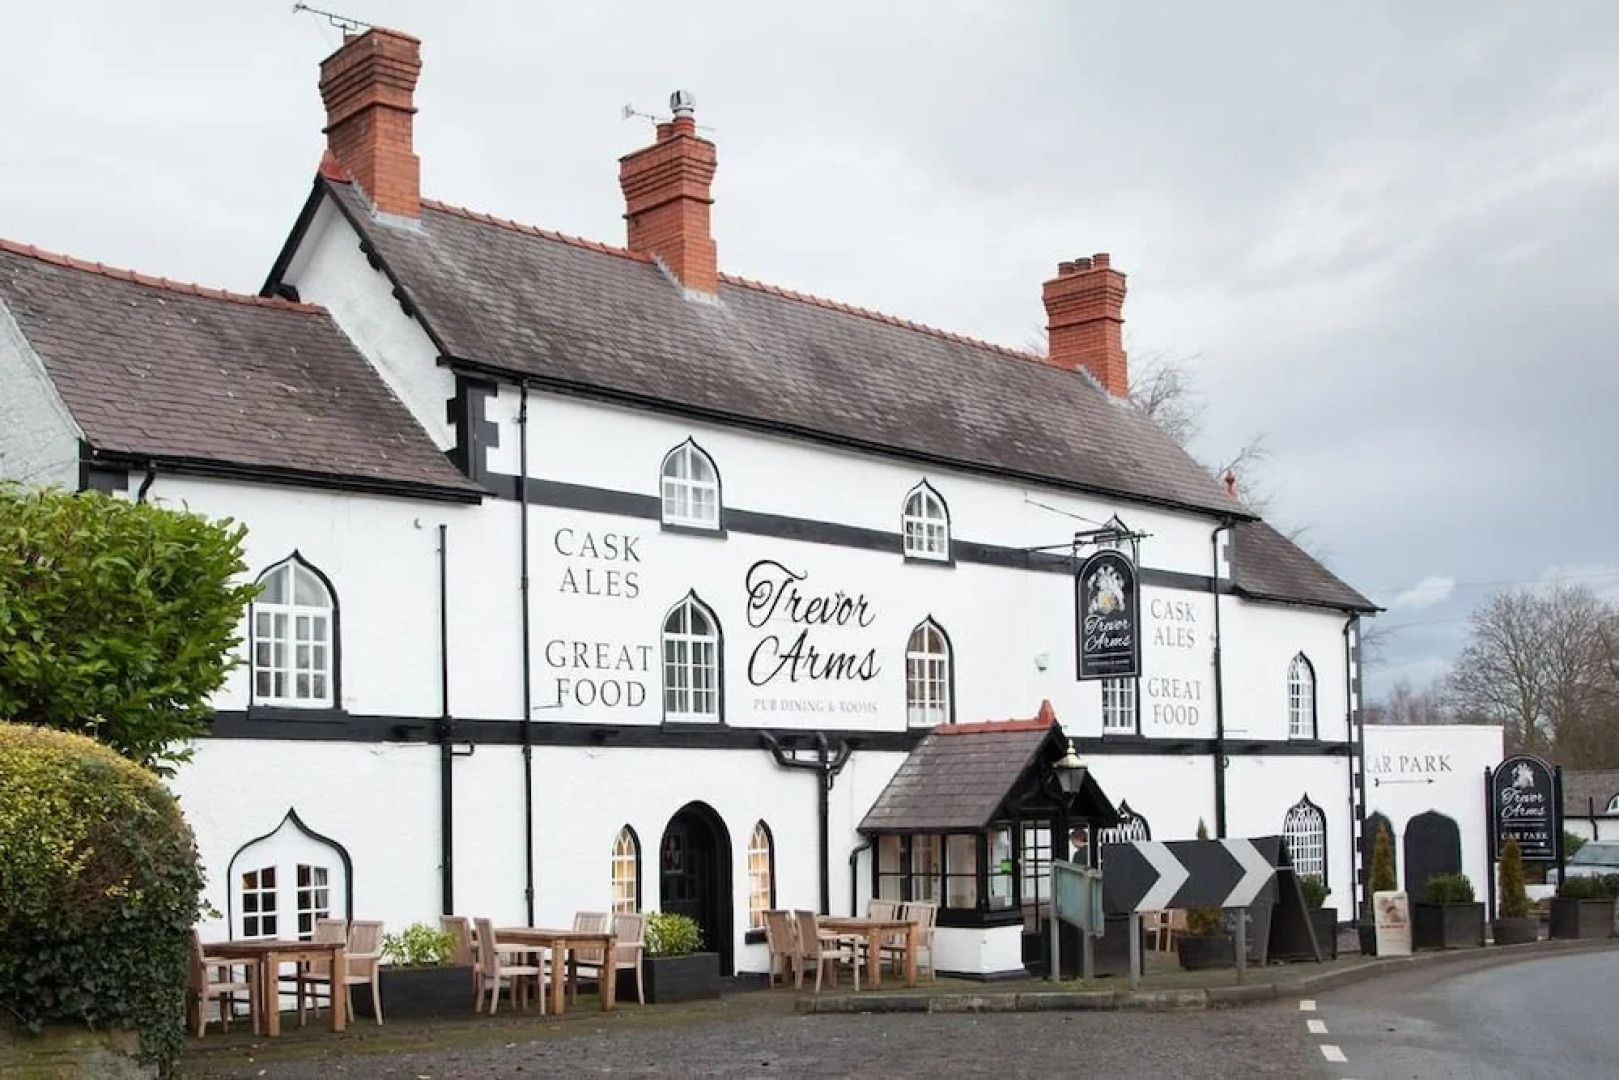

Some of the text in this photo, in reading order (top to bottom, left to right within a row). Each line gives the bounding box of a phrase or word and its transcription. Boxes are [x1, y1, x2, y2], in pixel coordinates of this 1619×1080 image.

[554, 527, 642, 563] CASK
[559, 566, 641, 599] ALES
[746, 559, 876, 629] Trevor
[1150, 598, 1196, 622] CASK
[1085, 614, 1131, 635] Trevor
[1085, 632, 1132, 652] Arms
[1153, 626, 1196, 648] ALES
[545, 639, 654, 673] GREAT
[747, 628, 881, 686] Arms
[556, 677, 647, 708] FOOD
[1147, 677, 1202, 701] GREAT
[753, 698, 777, 711] PUB
[780, 698, 825, 712] DINING
[839, 700, 879, 713] ROOMS
[1153, 703, 1199, 726] FOOD
[1399, 755, 1452, 773] PARK
[1501, 787, 1546, 805] Trevor
[1501, 803, 1546, 818] Arms
[1500, 831, 1549, 840] CAR PARK
